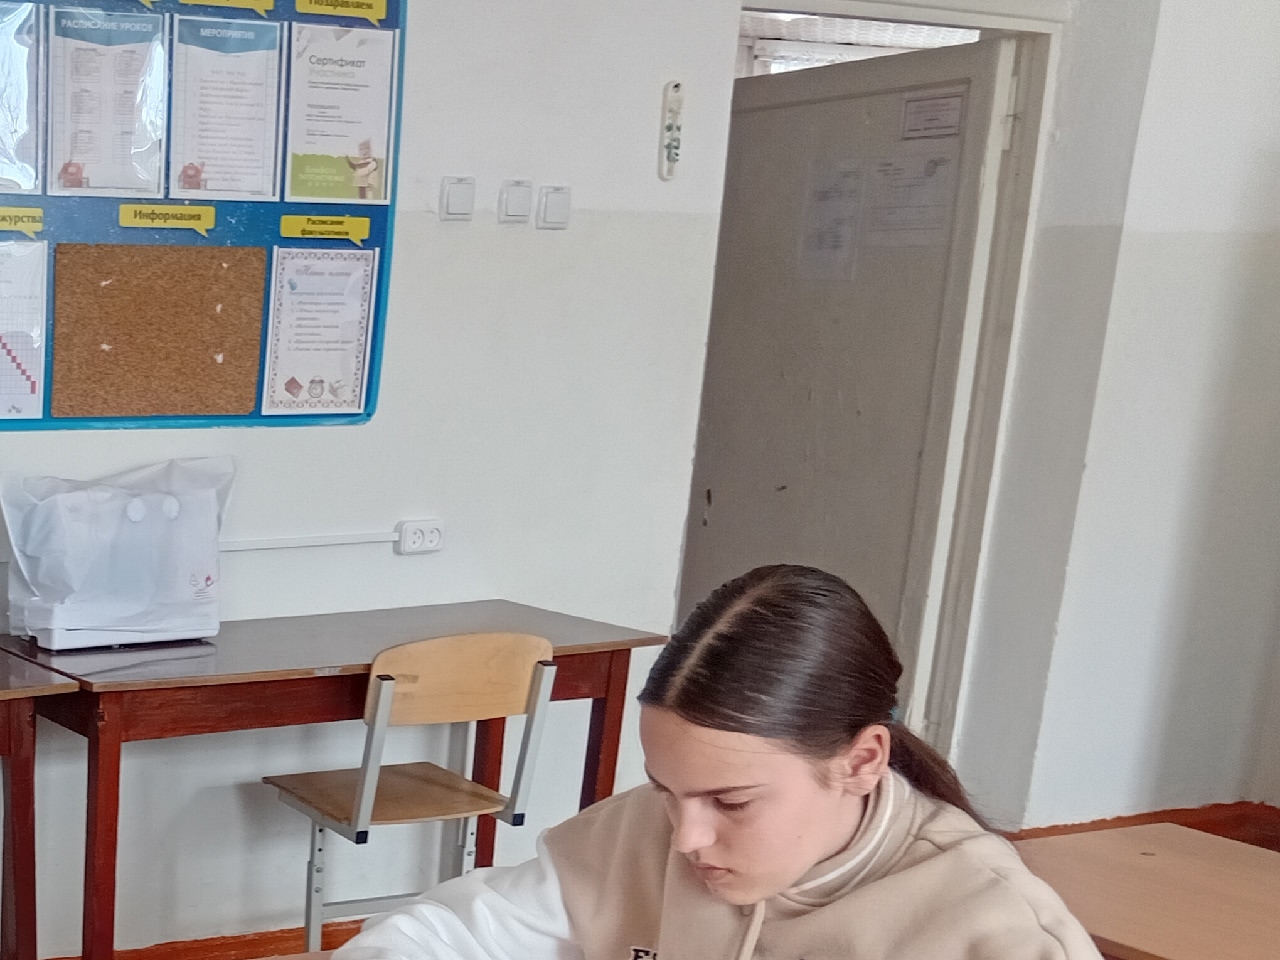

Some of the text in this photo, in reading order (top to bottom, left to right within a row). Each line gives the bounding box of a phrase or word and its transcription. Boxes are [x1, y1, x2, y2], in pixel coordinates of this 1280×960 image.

[200, 28, 256, 40] МЕРОПРИЯТИЯ
[308, 54, 365, 68] Сертификат
[134, 210, 202, 224] Информация
